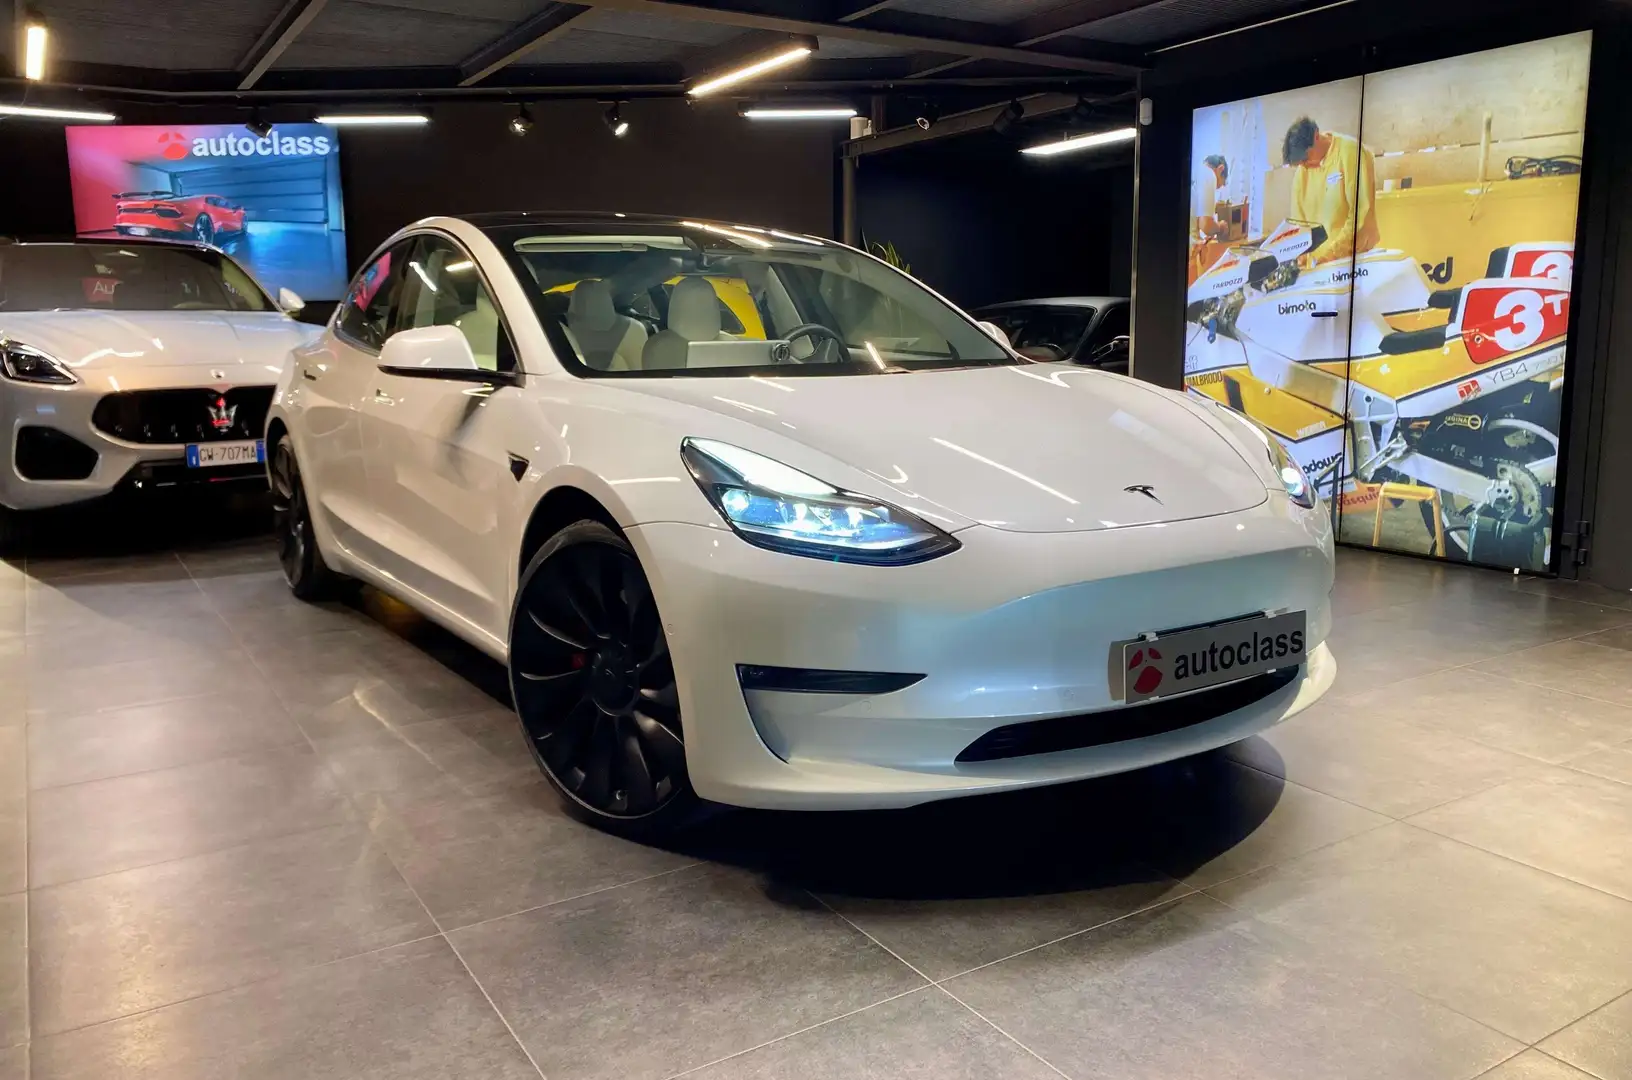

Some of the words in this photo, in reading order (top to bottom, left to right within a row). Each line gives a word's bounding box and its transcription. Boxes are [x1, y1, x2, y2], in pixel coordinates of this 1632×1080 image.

[193, 131, 331, 156] autoclass
[1332, 267, 1369, 282] bimota
[1278, 300, 1316, 315] bimota
[1485, 362, 1528, 385] YB4
[1174, 631, 1303, 680] autoclass
